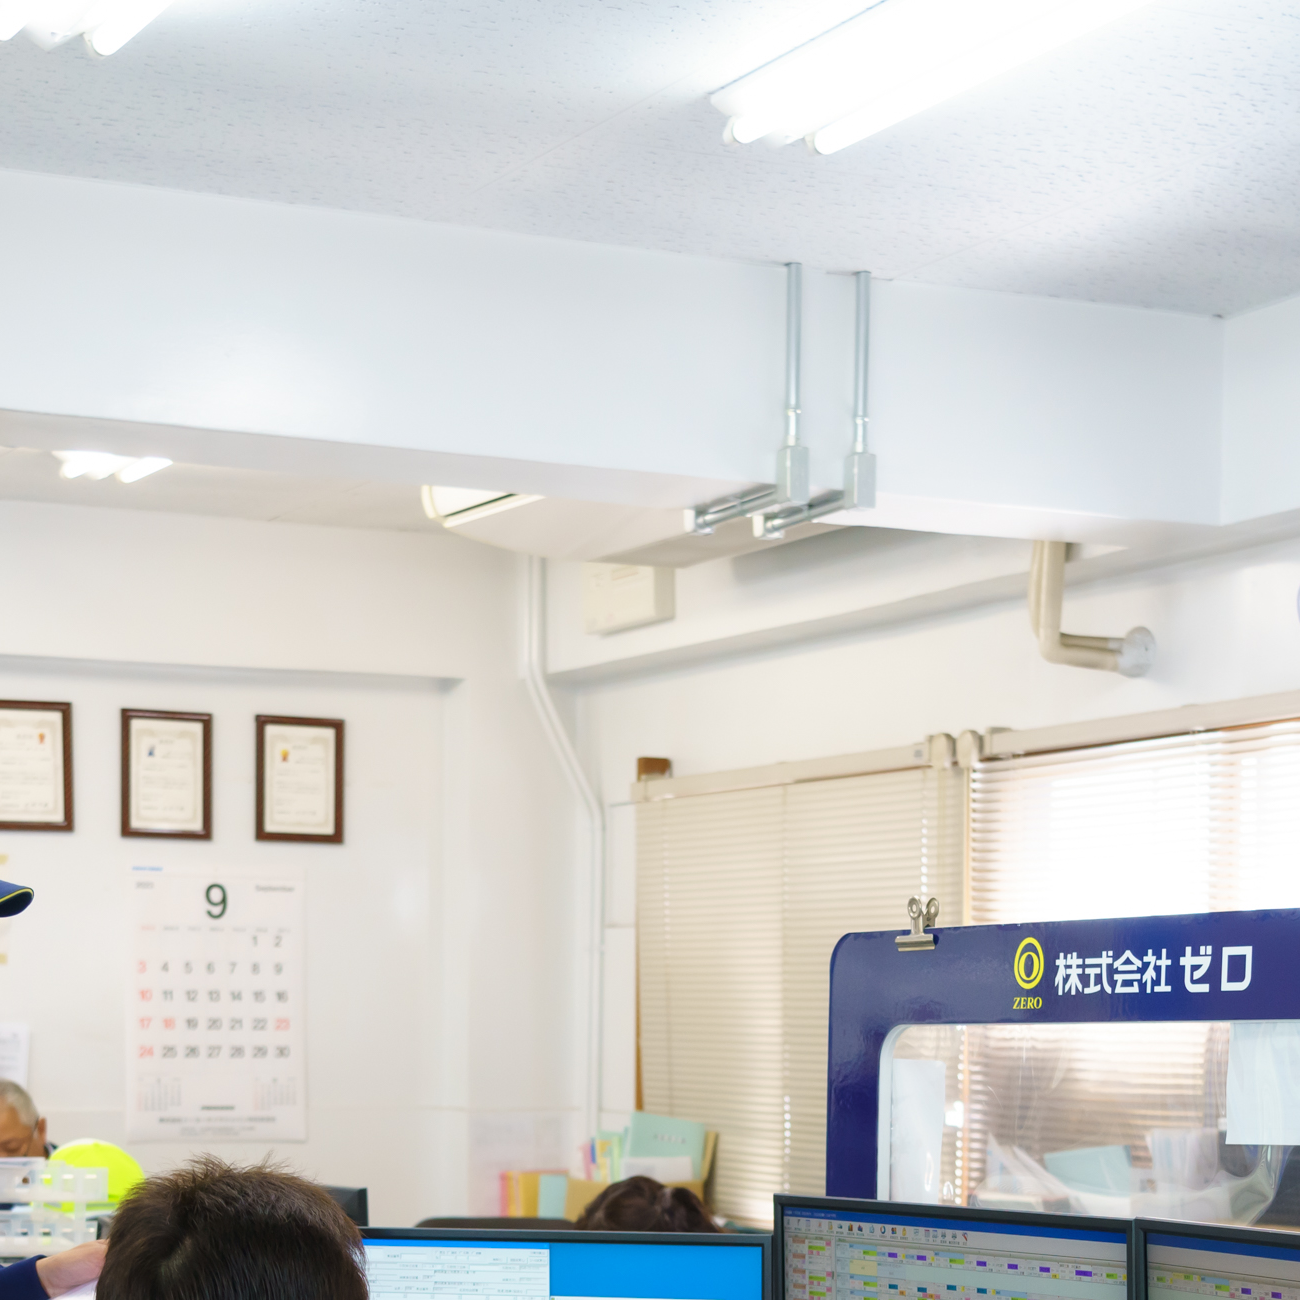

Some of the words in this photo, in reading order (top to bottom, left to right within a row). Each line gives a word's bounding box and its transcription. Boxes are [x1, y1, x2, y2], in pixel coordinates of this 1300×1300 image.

[205, 883, 228, 919] 9
[252, 935, 257, 947] 1
[274, 935, 282, 947] 2
[138, 961, 146, 973] 3
[161, 961, 169, 973] 4
[184, 962, 192, 974] 5
[207, 962, 215, 974] 6
[229, 962, 237, 974] 7
[252, 963, 260, 975] 8
[274, 963, 282, 975] 9
[1054, 945, 1253, 996] 株式会社ゼロ
[139, 989, 152, 1001] 10
[162, 990, 174, 1001] 11
[185, 990, 198, 1002] 12
[208, 990, 220, 1002] 13
[229, 990, 242, 1002] 14
[253, 991, 265, 1003] 15
[1012, 997, 1043, 1010] ZERO
[139, 1018, 152, 1029] 17
[186, 1018, 198, 1030] 19
[207, 1019, 222, 1030] 20
[229, 1019, 243, 1030] 21
[253, 1019, 267, 1031] 22
[275, 1019, 290, 1031] 23
[139, 1046, 153, 1058] 24
[162, 1046, 177, 1058] 25
[185, 1047, 199, 1058] 26
[207, 1046, 221, 1058] 27
[230, 1047, 244, 1058] 28
[253, 1047, 267, 1058] 29
[275, 1047, 290, 1059] 30
